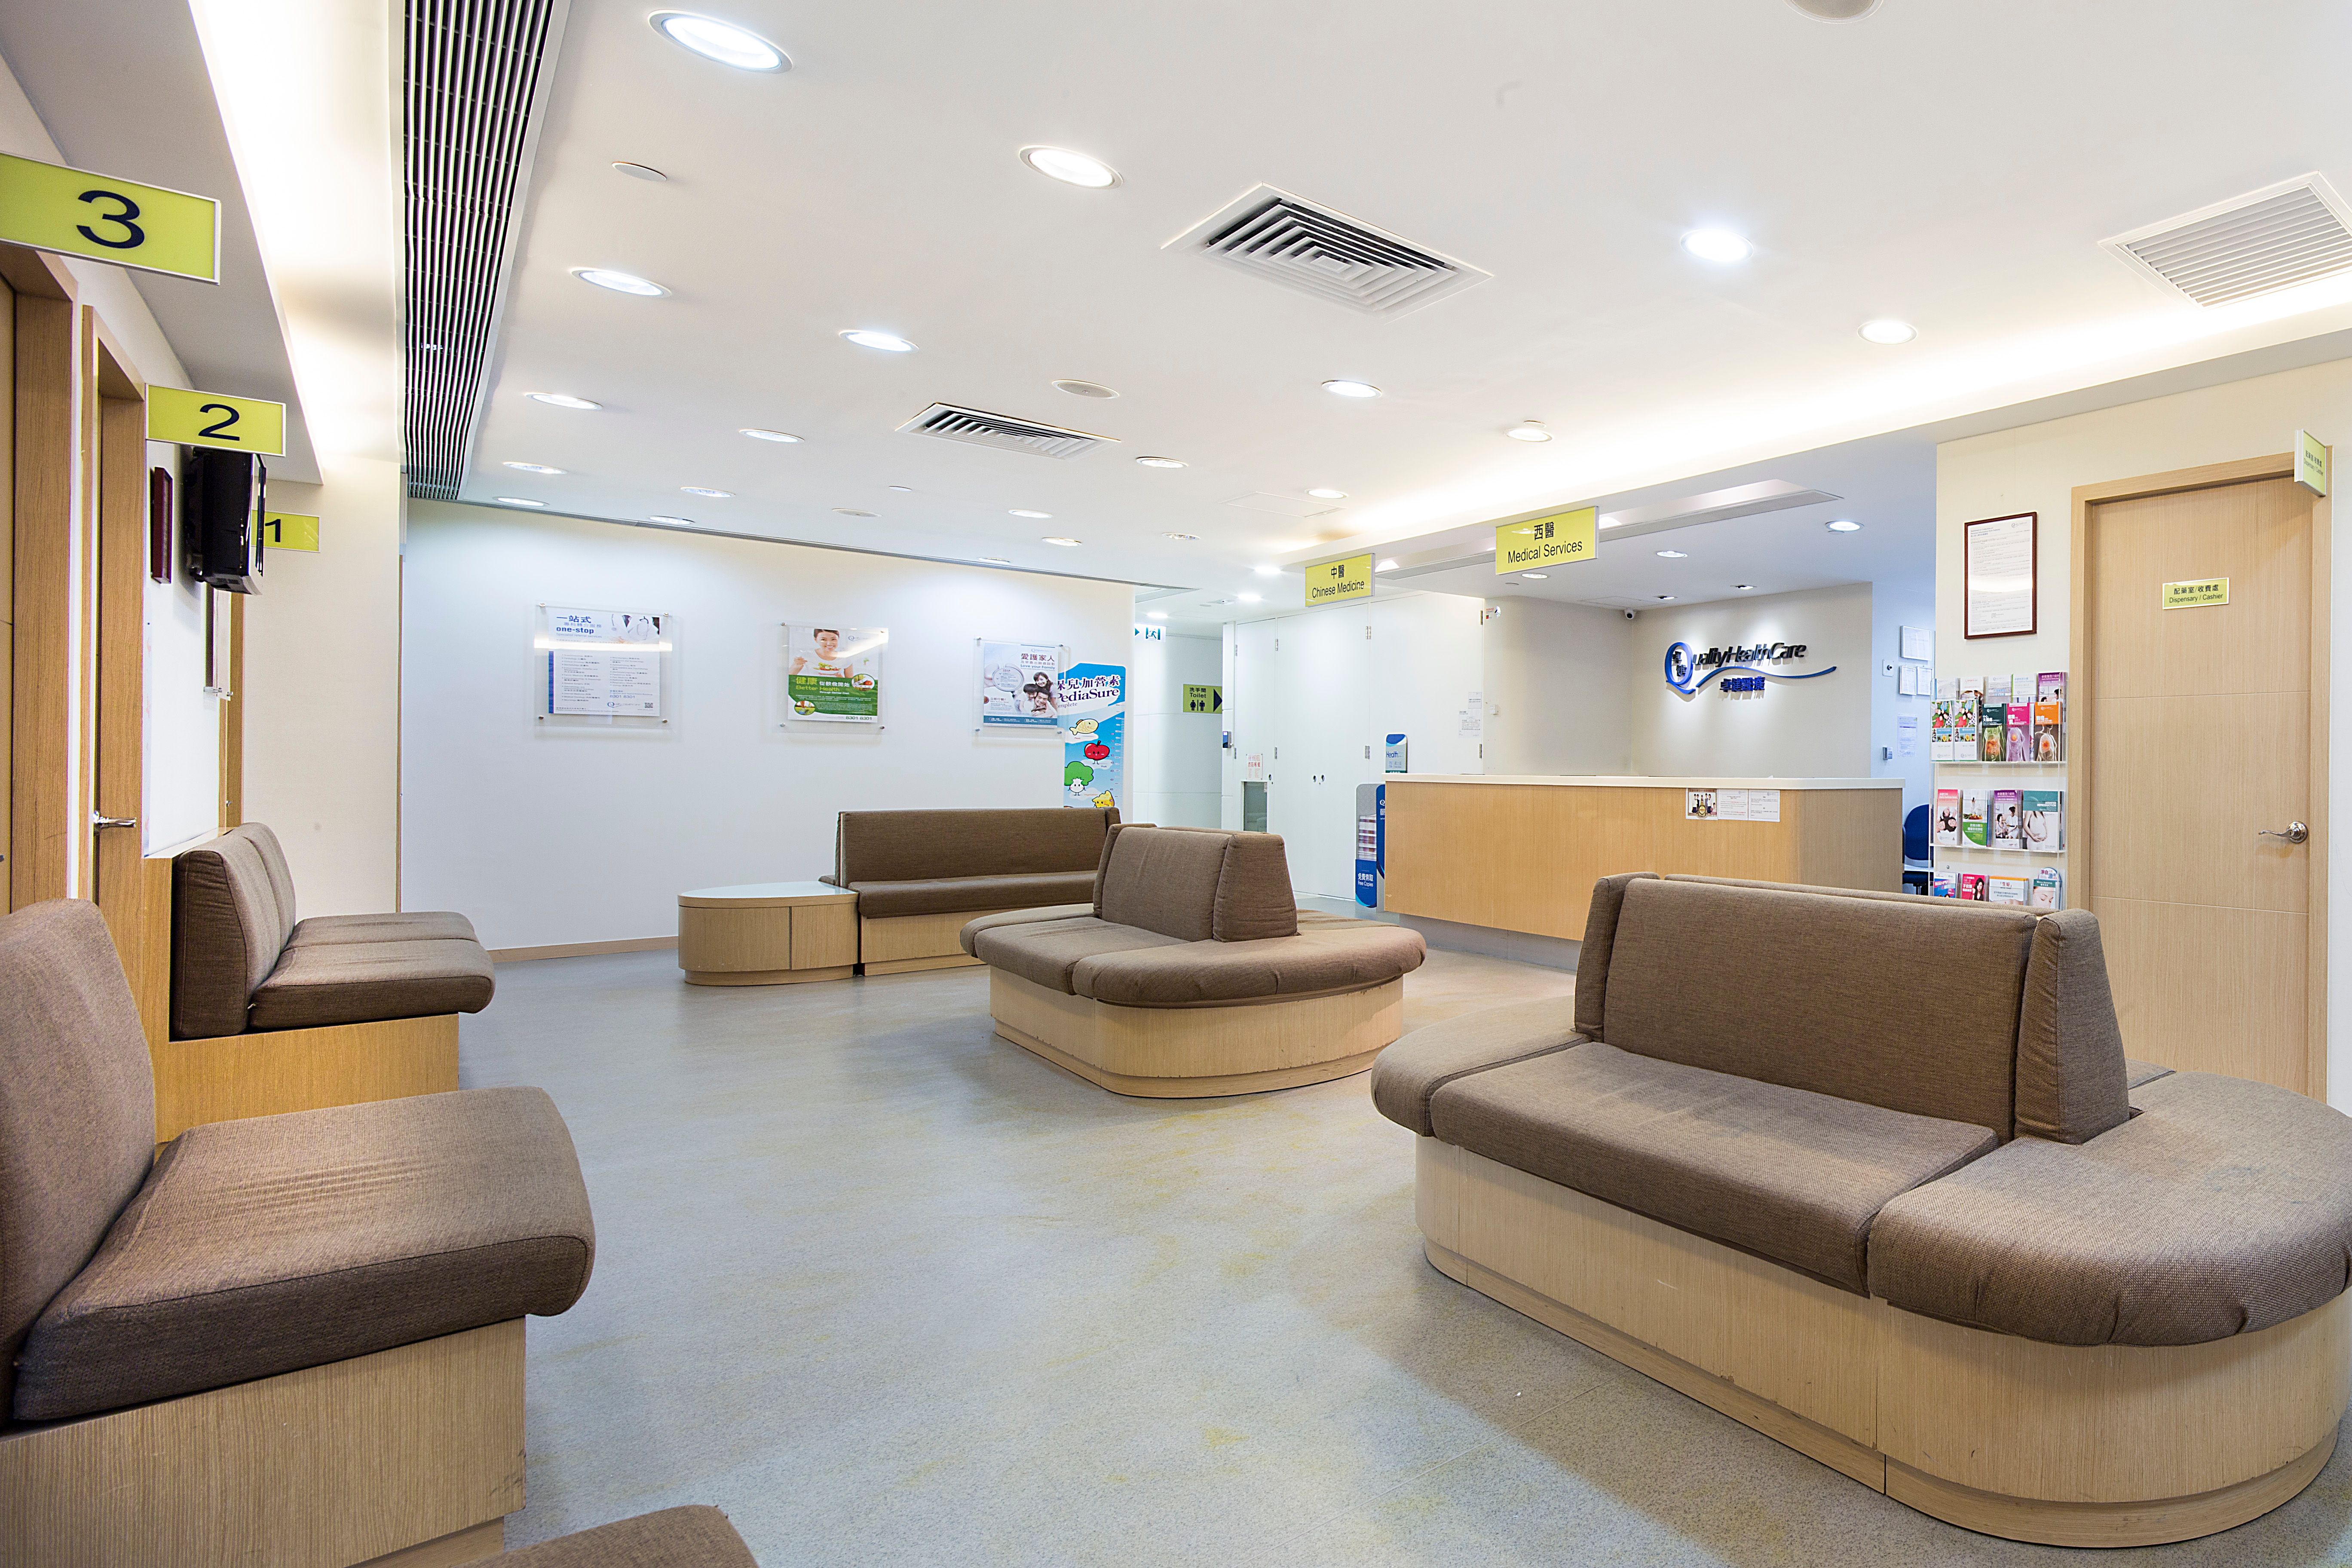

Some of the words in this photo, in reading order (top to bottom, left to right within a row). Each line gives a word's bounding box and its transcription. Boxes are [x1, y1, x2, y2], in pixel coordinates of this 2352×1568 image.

[76, 190, 145, 249] 3
[198, 404, 241, 441] 2
[265, 519, 281, 543] 1
[1534, 521, 1554, 541] 西醫
[1508, 545, 1540, 564] Medical
[1544, 541, 1583, 557] Services
[1331, 564, 1344, 579] 中醫
[1312, 586, 1335, 598] Chinese
[1337, 580, 1364, 594] Medicine
[2174, 584, 2219, 595] 配藥室/收費處
[556, 615, 592, 624] 一站式
[1021, 653, 1055, 662] 愛護家人
[796, 676, 818, 685] 健康
[1720, 676, 1766, 693] 卓健醫療
